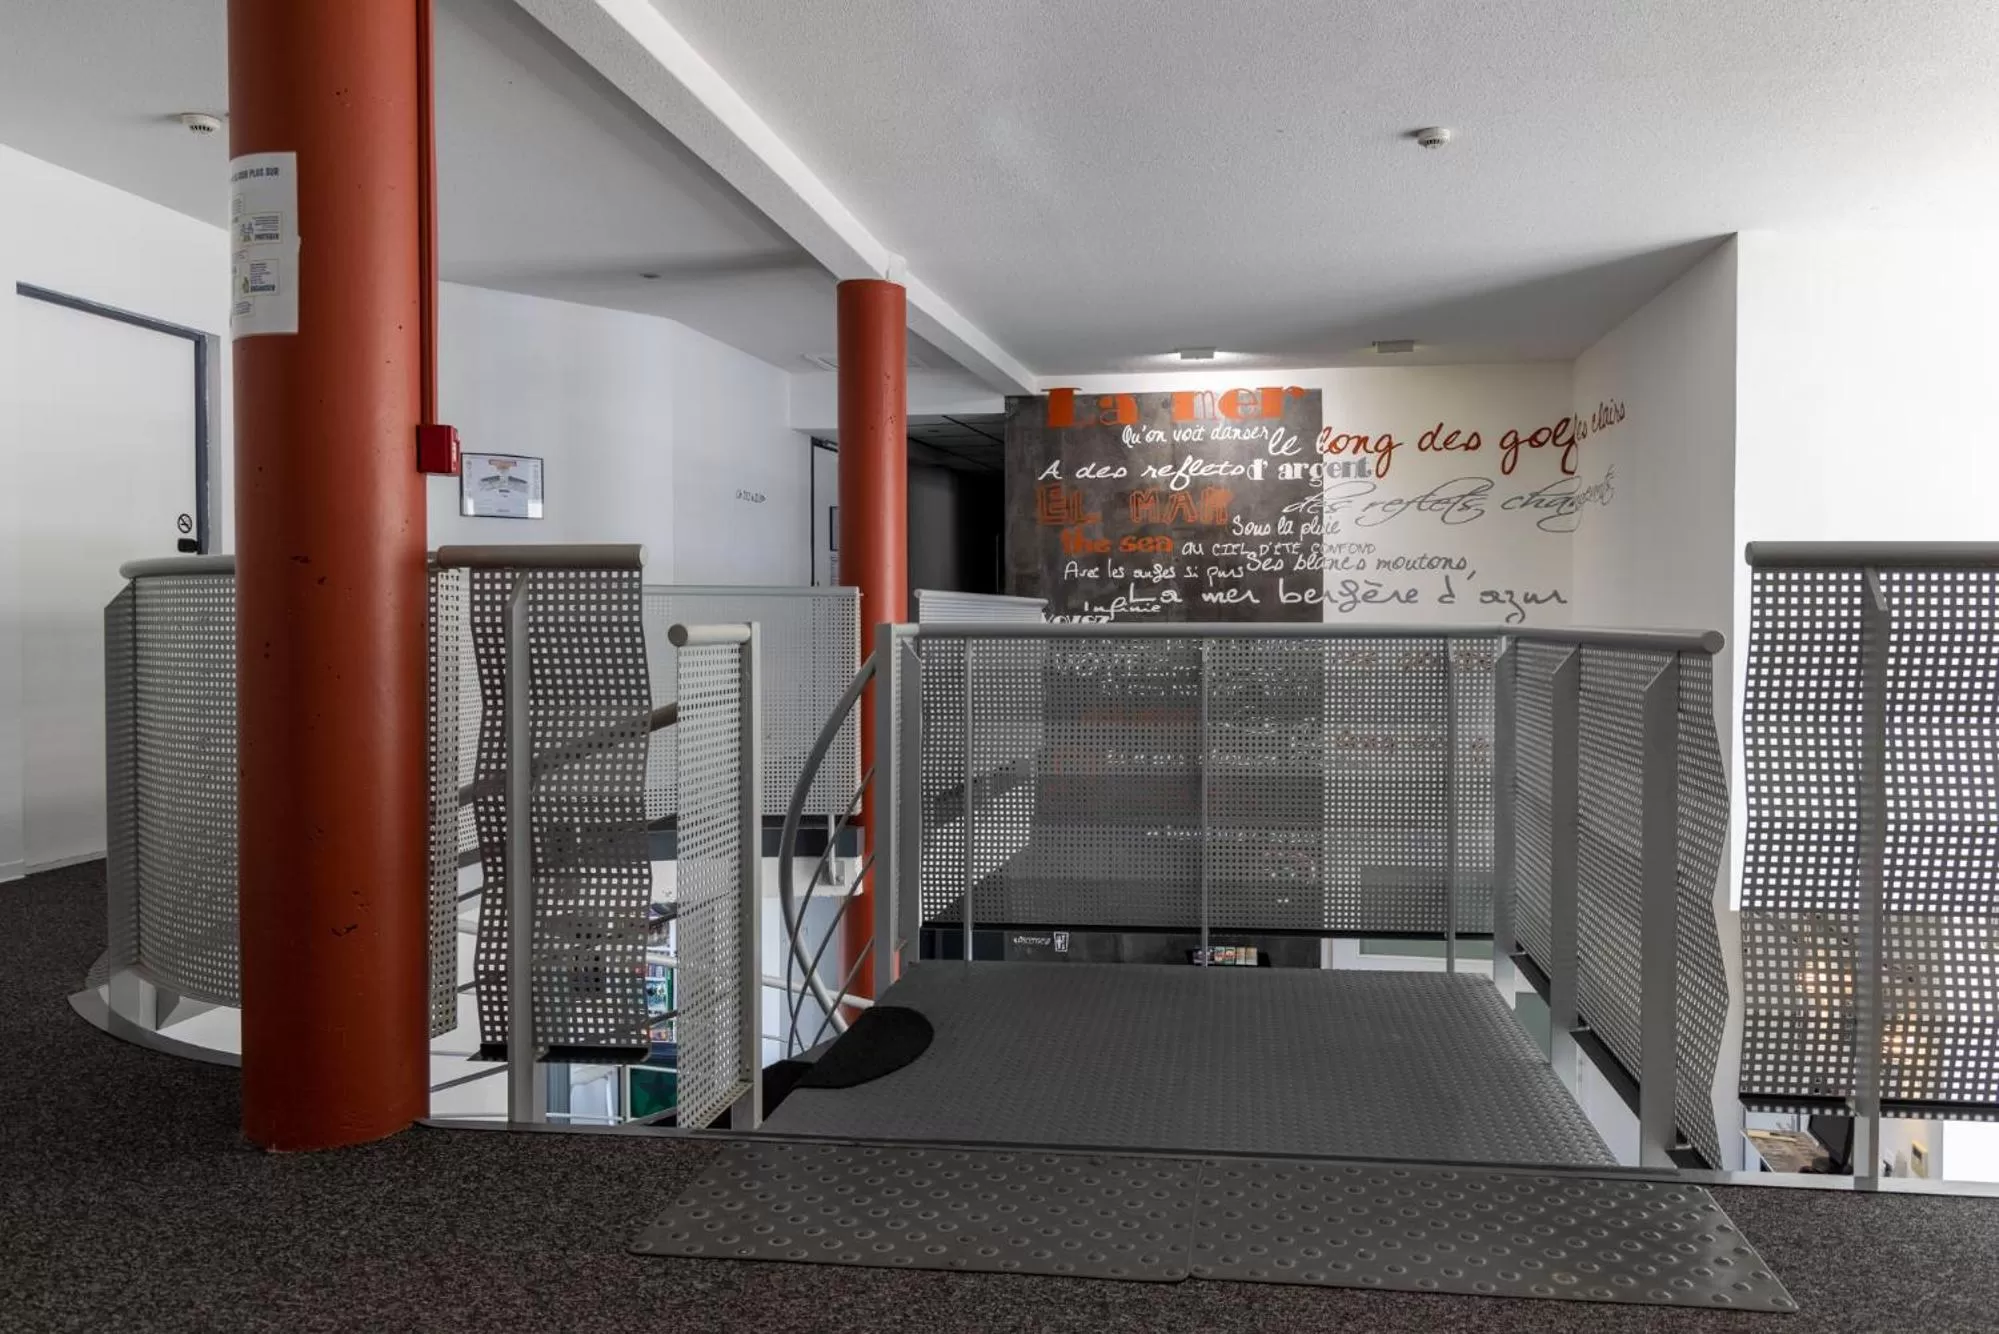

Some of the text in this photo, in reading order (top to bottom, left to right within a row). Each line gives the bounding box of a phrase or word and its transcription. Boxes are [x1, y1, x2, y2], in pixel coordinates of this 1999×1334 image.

[1171, 385, 1305, 422] mer
[1121, 422, 1269, 448] Qu'on voit danser
[1268, 426, 1302, 455] le
[1315, 426, 1403, 478] long
[1417, 422, 1482, 452] des
[1038, 459, 1063, 480] A
[1075, 462, 1128, 479] des
[1140, 455, 1245, 491] reflets
[1129, 486, 1234, 526] MAR
[1231, 514, 1271, 536] Sous
[1277, 515, 1294, 536] la
[1246, 551, 1284, 571] Ses
[1293, 552, 1366, 572] blancs
[1129, 582, 1183, 604] La
[1200, 587, 1261, 604] mer
